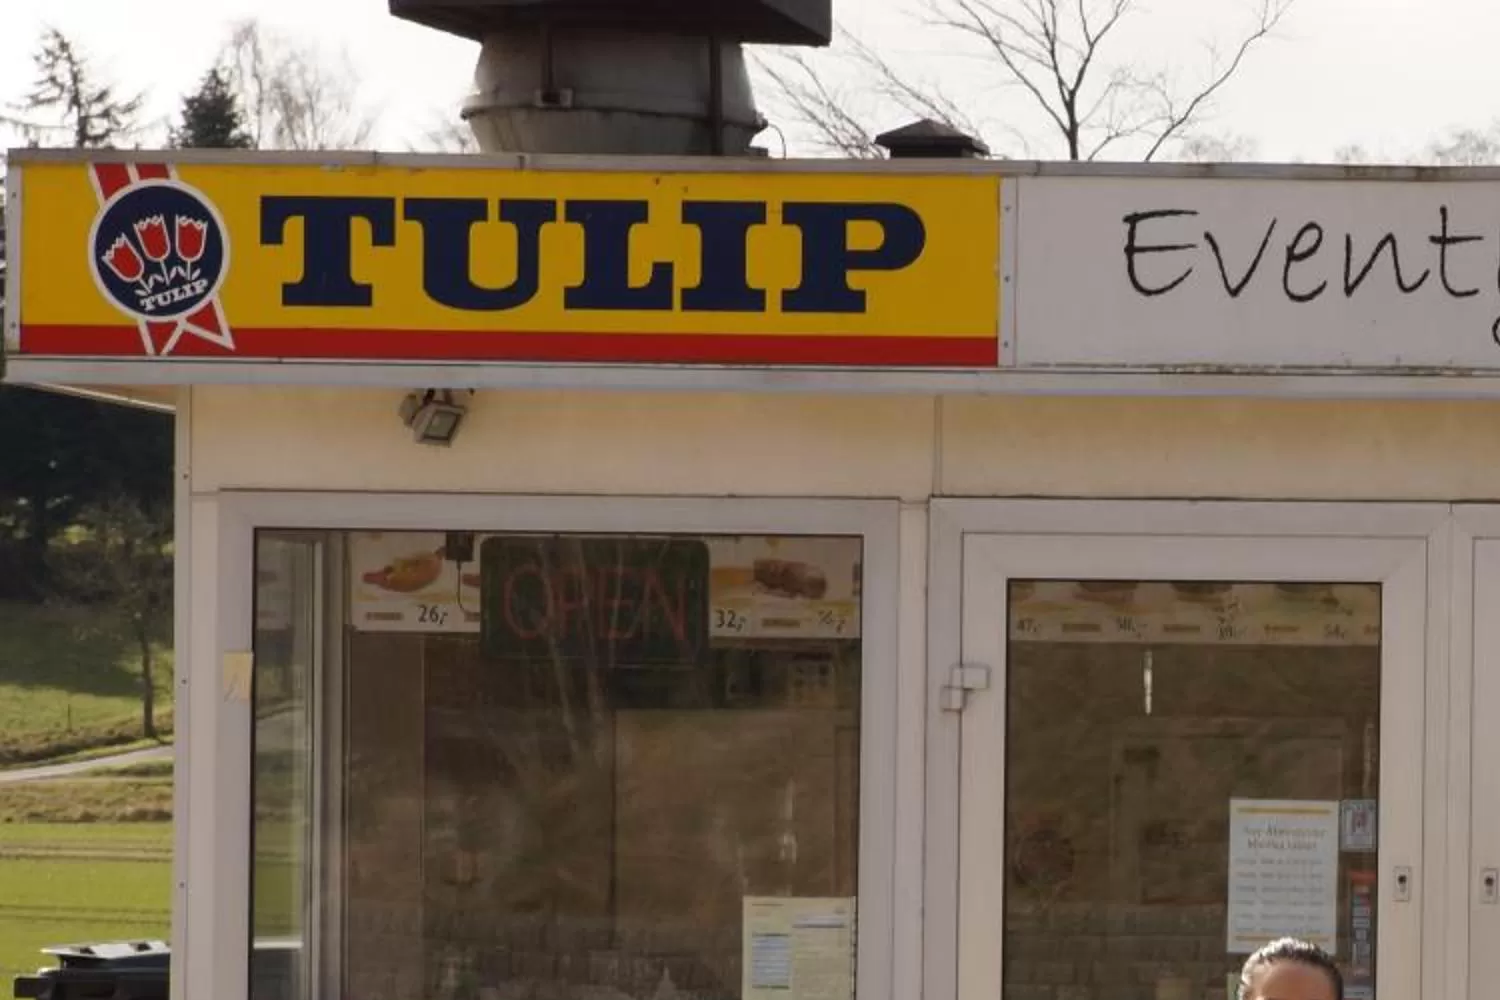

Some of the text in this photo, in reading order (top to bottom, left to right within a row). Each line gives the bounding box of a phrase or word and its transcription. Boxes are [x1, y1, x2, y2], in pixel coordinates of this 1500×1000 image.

[260, 194, 927, 314] TULIP
[139, 278, 209, 312] TULIP
[501, 562, 689, 642] OPEN
